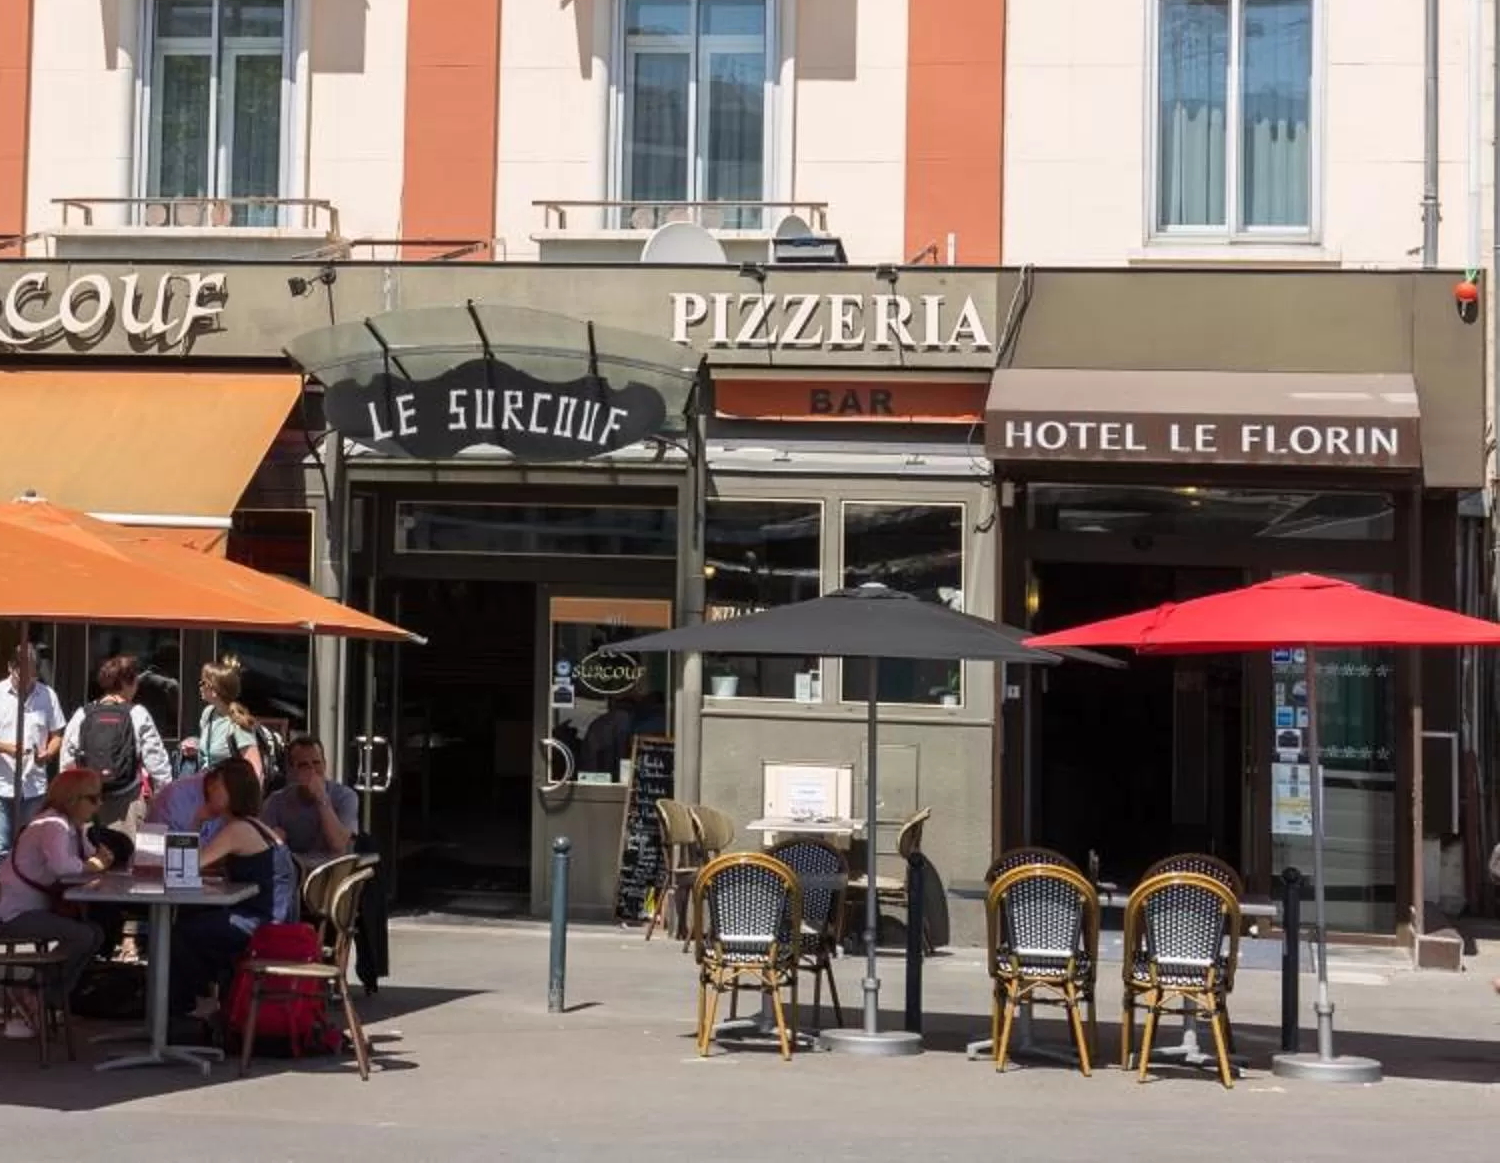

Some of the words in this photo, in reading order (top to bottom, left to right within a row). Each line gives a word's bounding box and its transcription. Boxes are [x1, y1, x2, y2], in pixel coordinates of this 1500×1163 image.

[669, 292, 993, 347] PIZZERIA
[368, 393, 417, 441] LE
[448, 388, 628, 445] SURCOUF
[809, 388, 894, 415] BAR
[1005, 420, 1146, 450] HOTEL
[1170, 423, 1217, 451] LE
[1241, 425, 1399, 455] FLORIN
